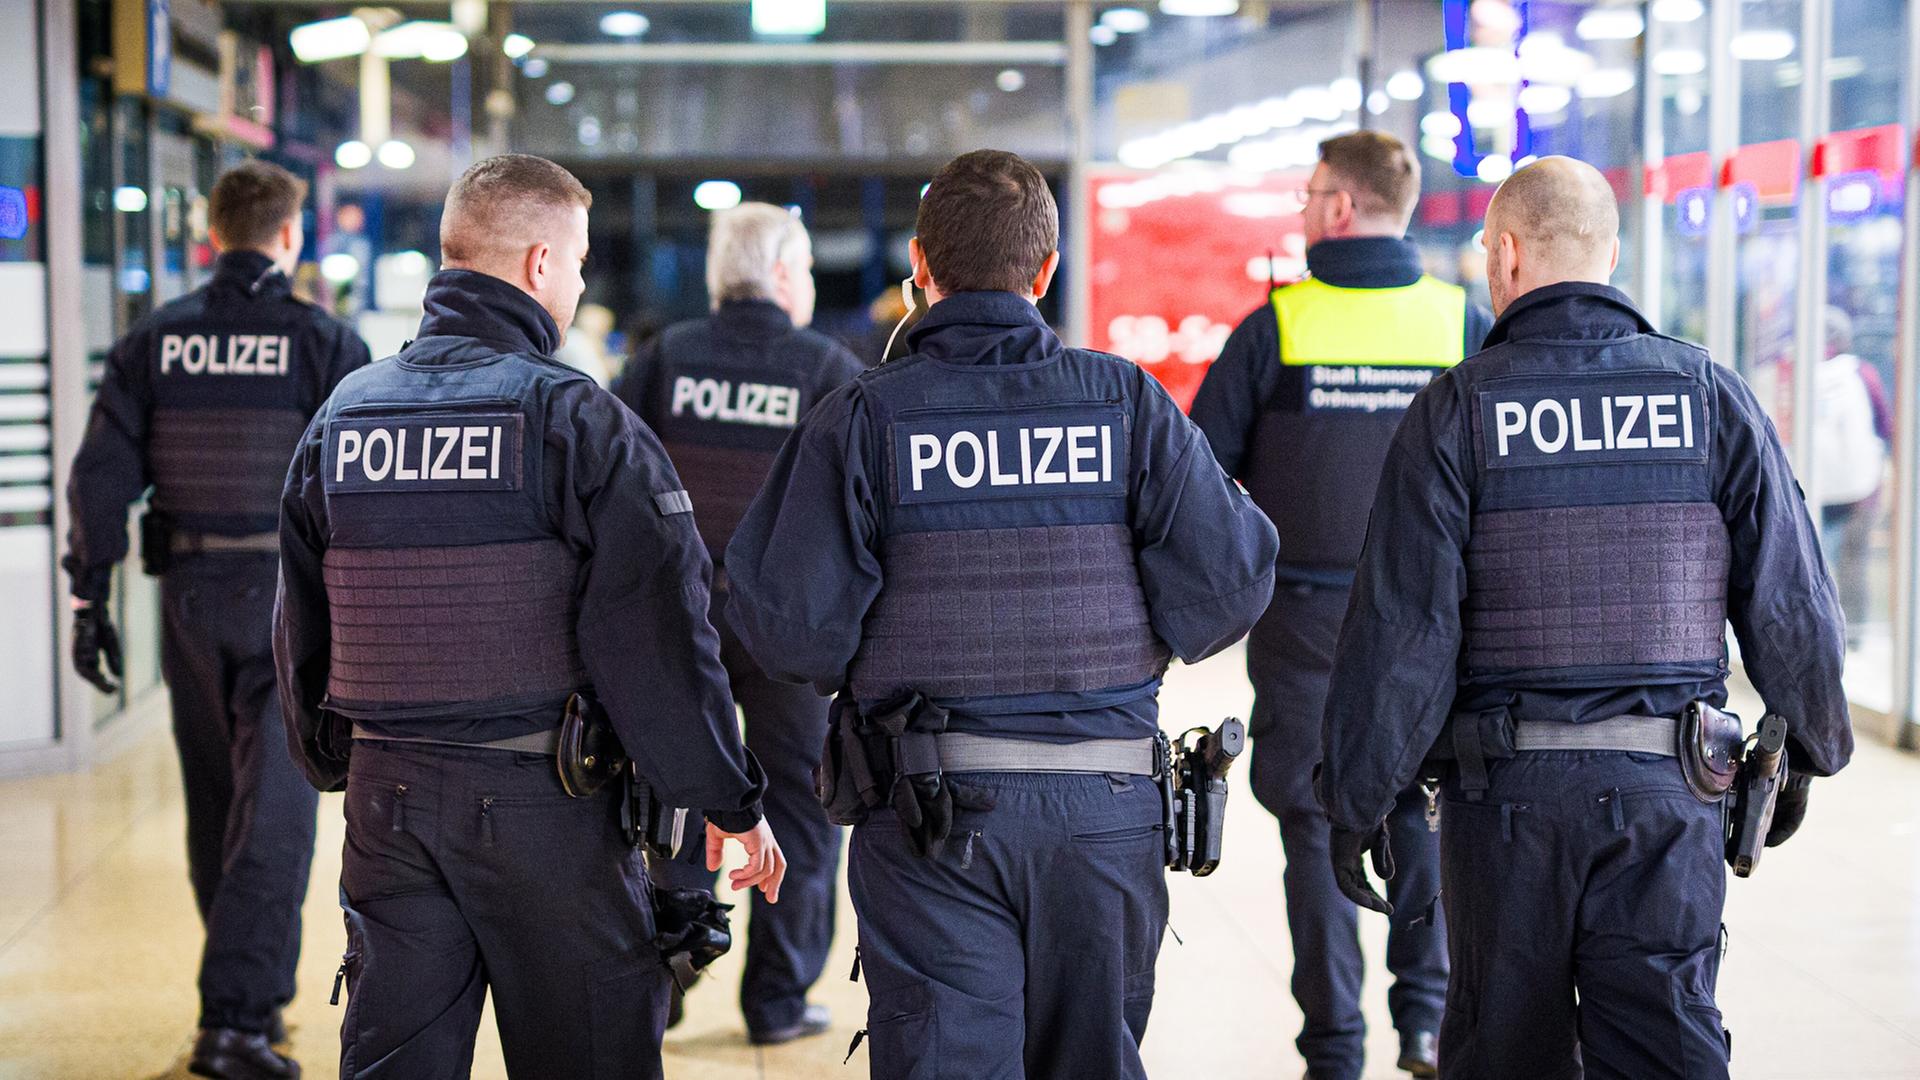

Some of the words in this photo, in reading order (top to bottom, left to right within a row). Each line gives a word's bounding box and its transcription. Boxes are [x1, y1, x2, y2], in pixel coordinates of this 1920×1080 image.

[161, 334, 289, 375] POLIZEI
[1312, 366, 1355, 385] Stadt
[672, 376, 799, 427] POLIZEI
[1495, 394, 1694, 457] POLIZEI
[335, 425, 502, 482] POLIZEI
[909, 425, 1112, 491] POLIZEI
